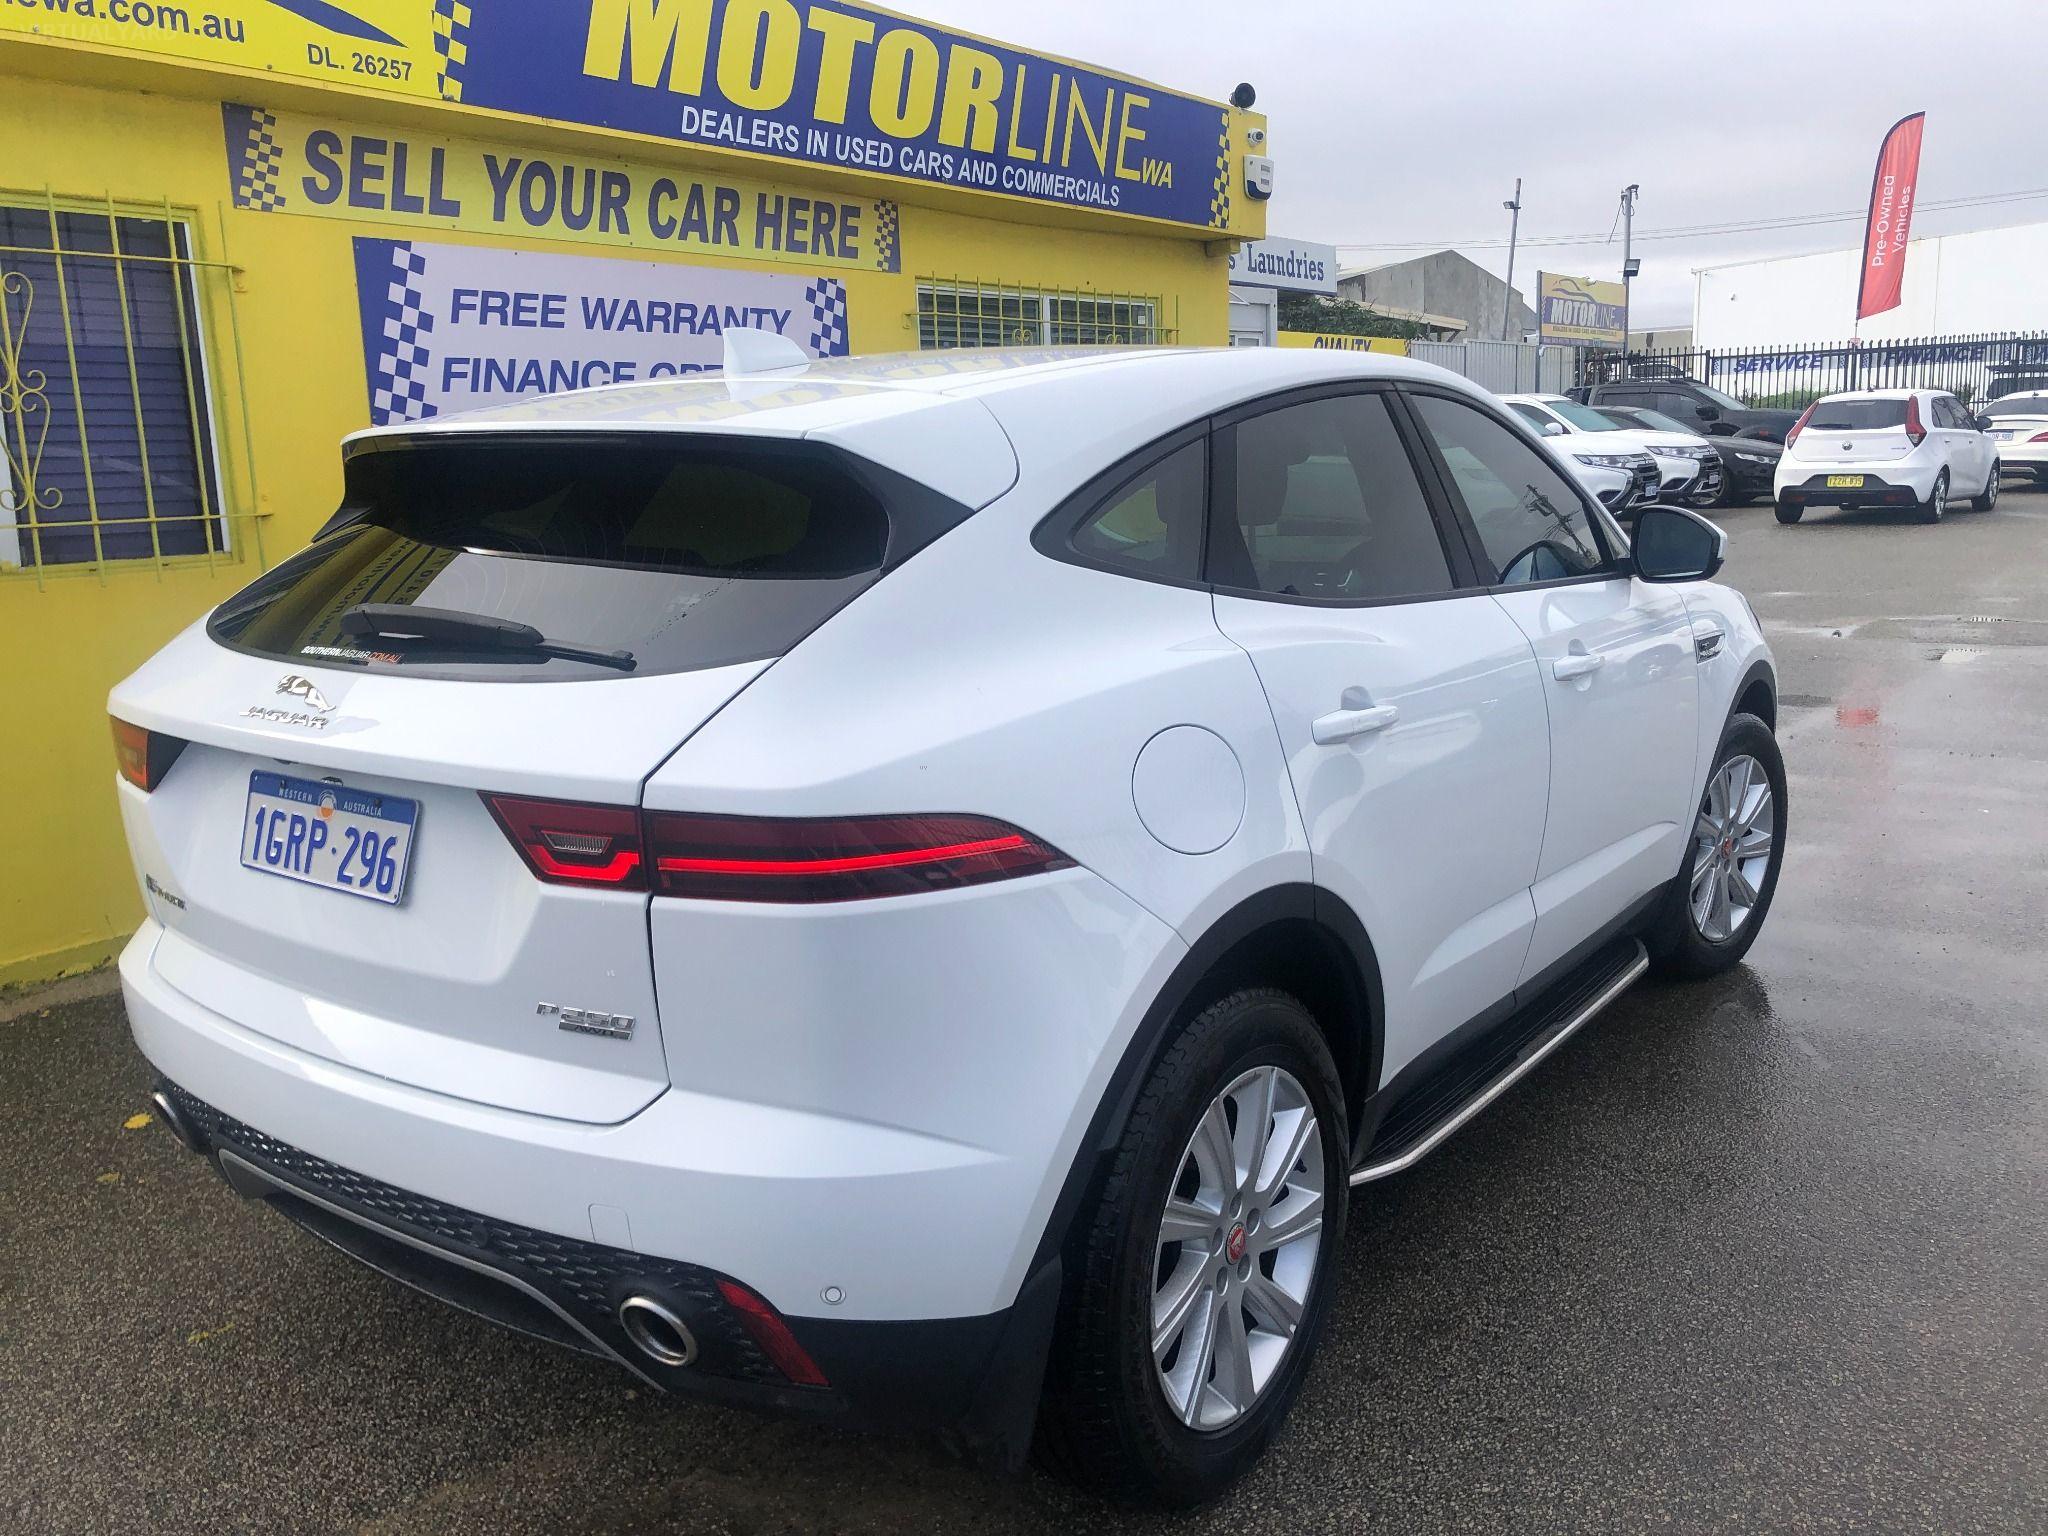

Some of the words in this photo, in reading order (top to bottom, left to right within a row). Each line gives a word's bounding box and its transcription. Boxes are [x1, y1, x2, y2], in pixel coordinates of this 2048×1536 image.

[307, 43, 345, 70] DL.
[351, 52, 412, 81] 26257
[682, 105, 800, 153] DEALERS
[806, 129, 828, 158] IN
[835, 134, 893, 168] USED
[900, 146, 953, 179] CARS
[958, 156, 996, 186] AND
[1002, 165, 1120, 207] COMMERCIALS
[302, 129, 461, 217] SELL
[482, 154, 630, 235] YOUR
[648, 177, 740, 247] CAR
[755, 192, 862, 260] HERE
[1871, 175, 1895, 267] Pre-Owned
[1891, 185, 1911, 253] Vehicles
[1246, 243, 1324, 282] Laundries
[450, 288, 567, 328] FREE
[581, 296, 792, 336] WARRANTY
[1550, 297, 1616, 329] MOTORLINE
[442, 356, 637, 394] FINANCE
[1734, 353, 1822, 373] SERVICE
[240, 704, 329, 730] JAGUAR
[279, 788, 313, 802] WESTERN
[343, 802, 382, 817] AUSTRALIA
